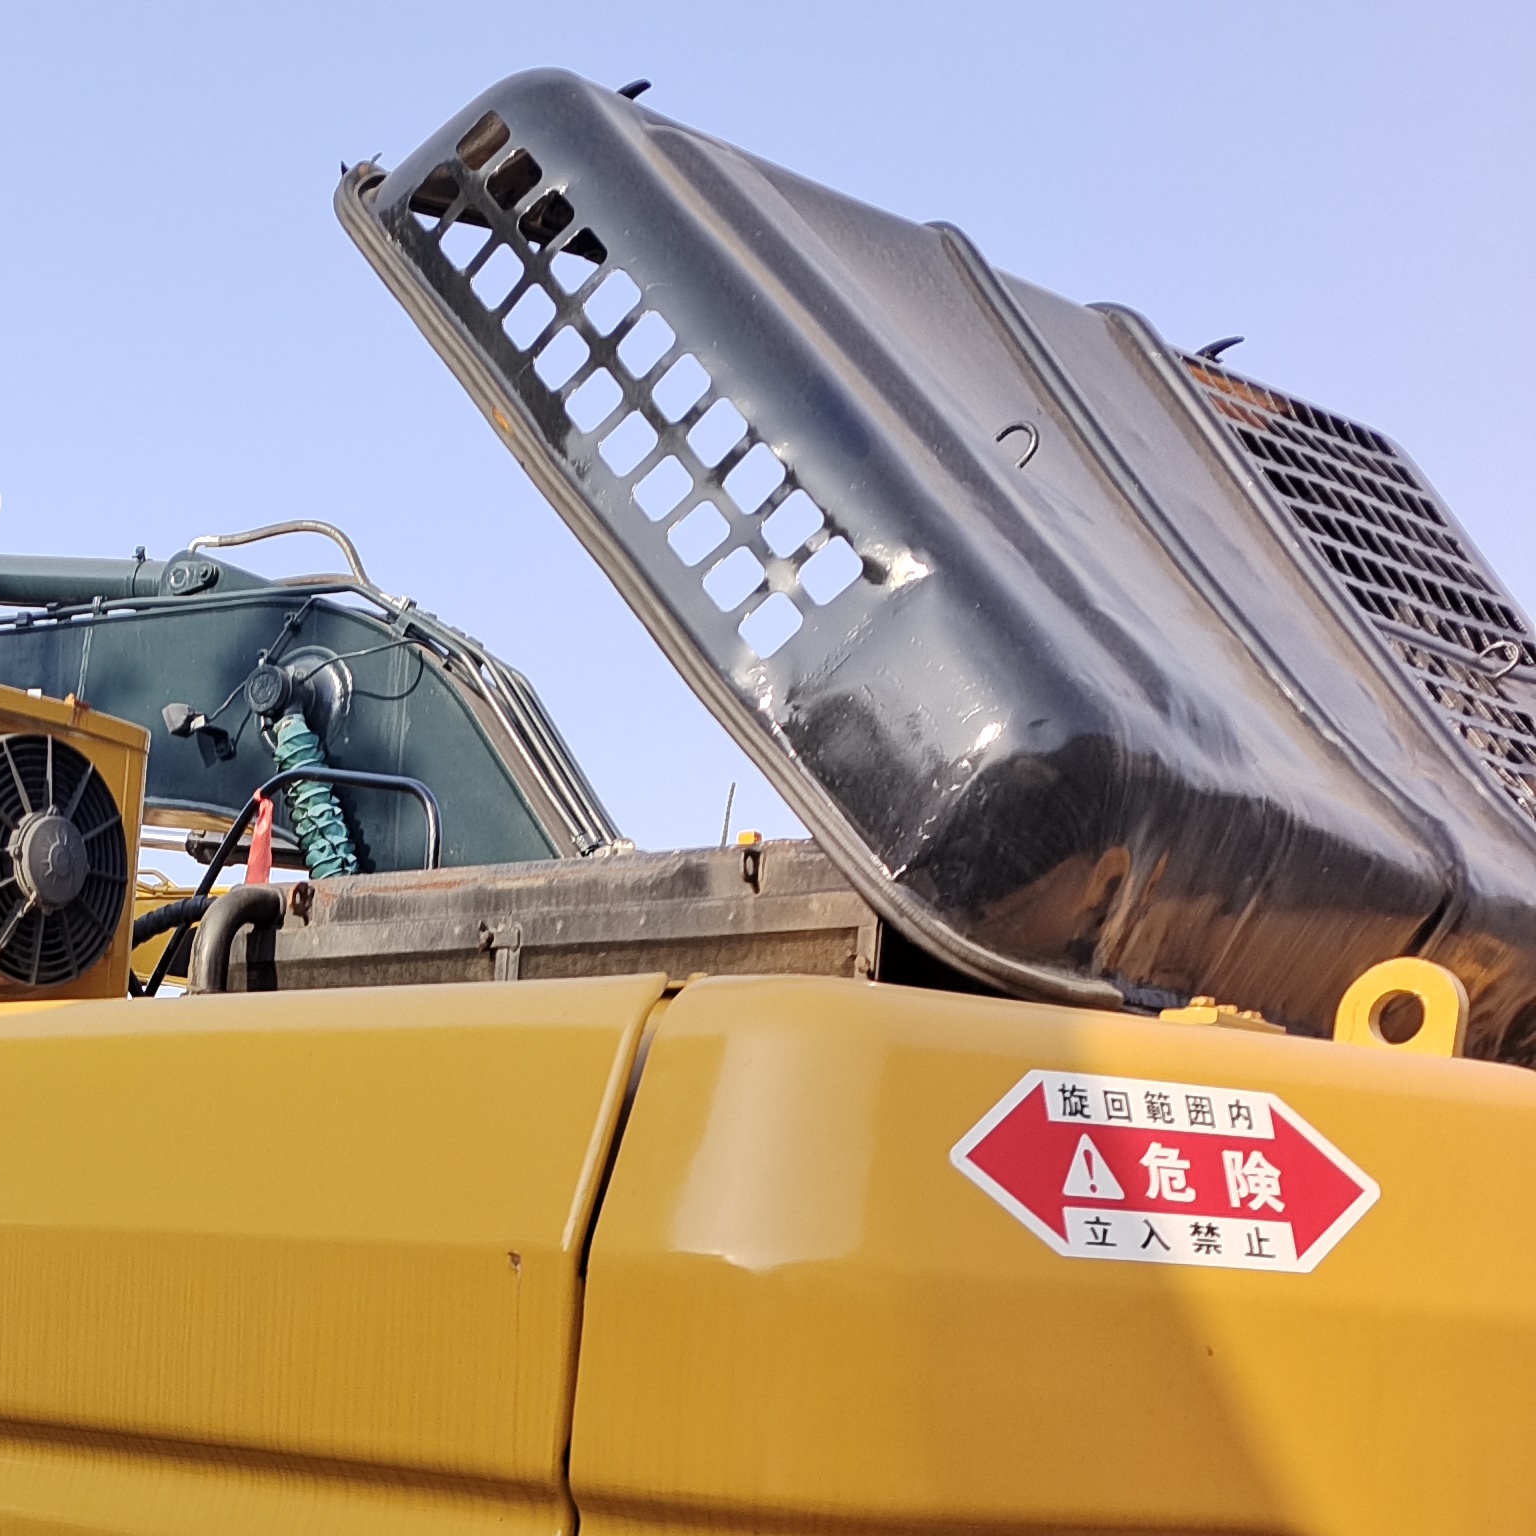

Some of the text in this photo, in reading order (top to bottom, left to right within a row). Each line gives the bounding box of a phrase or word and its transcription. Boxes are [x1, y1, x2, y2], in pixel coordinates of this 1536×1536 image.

[1058, 1083, 1254, 1130] 旋回範囲内
[1139, 1142, 1285, 1212] 危険
[1084, 1216, 1276, 1258] 立入禁止
